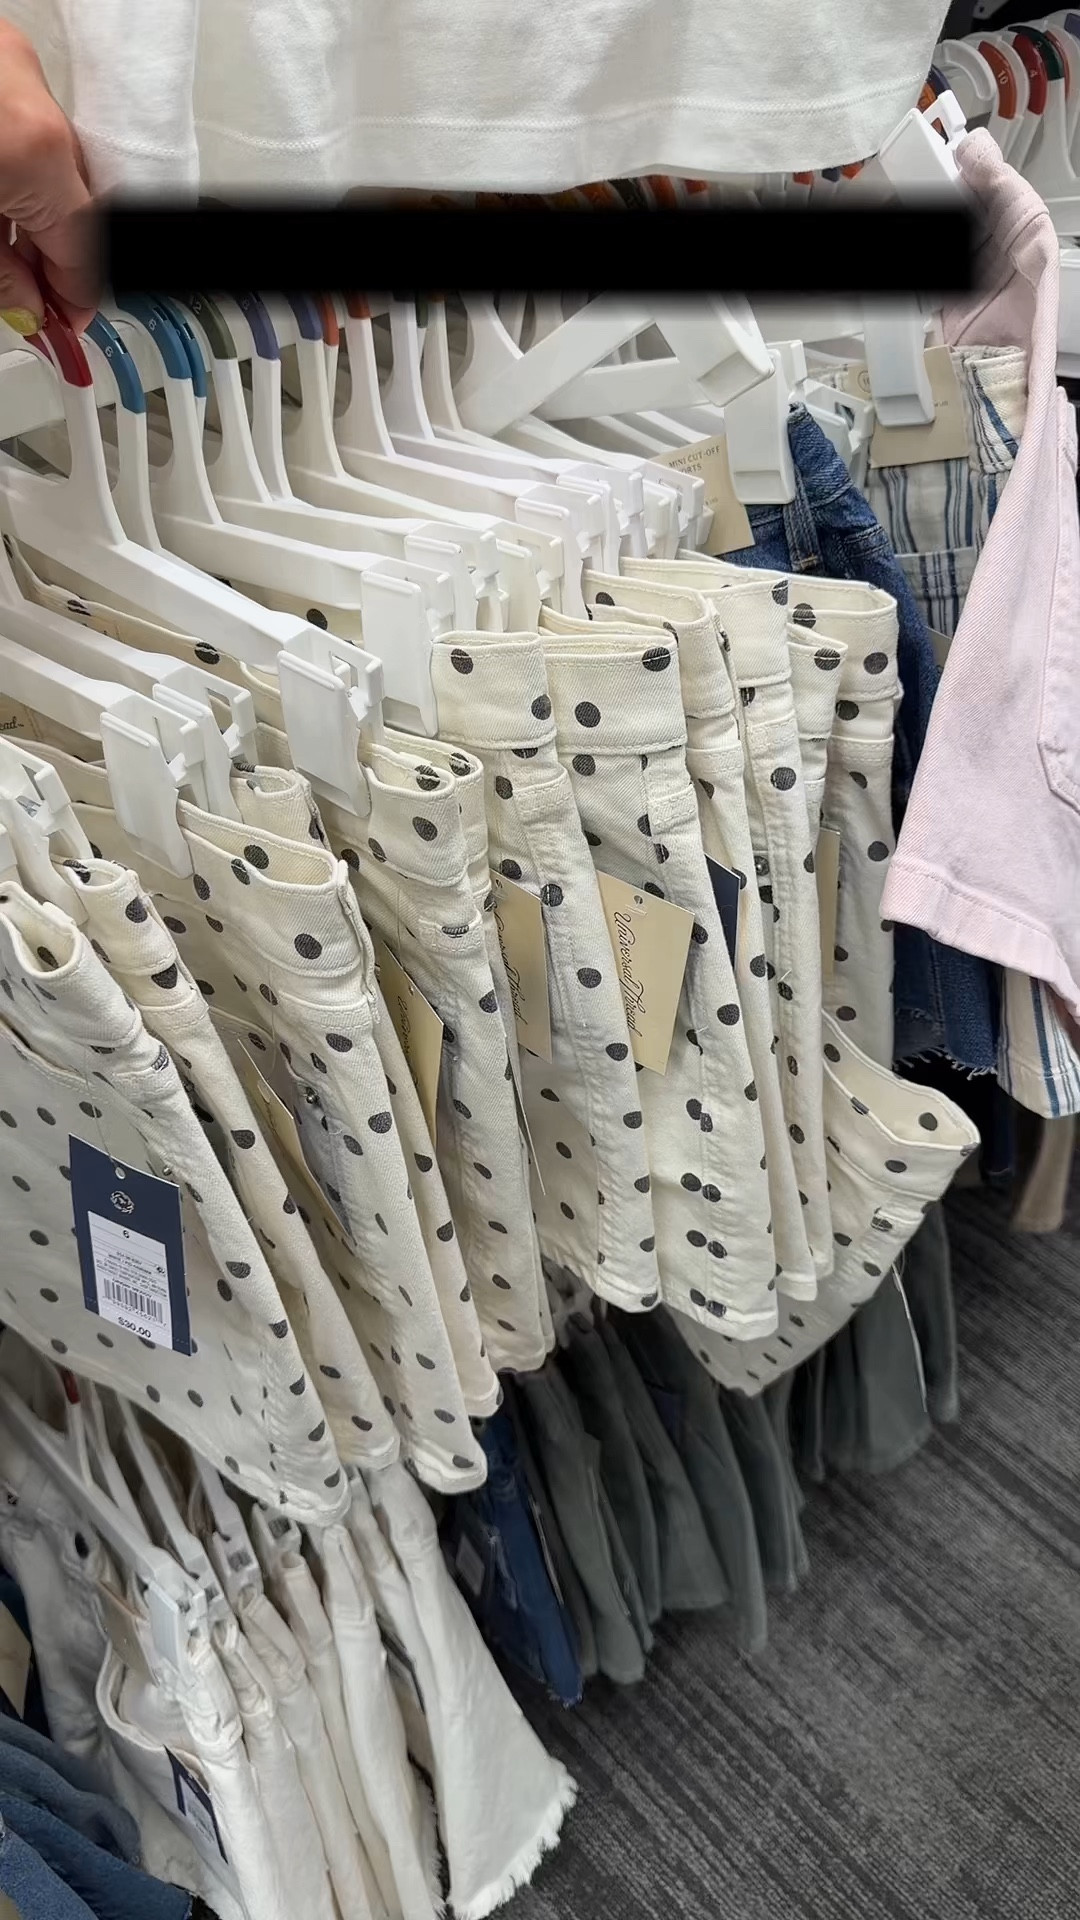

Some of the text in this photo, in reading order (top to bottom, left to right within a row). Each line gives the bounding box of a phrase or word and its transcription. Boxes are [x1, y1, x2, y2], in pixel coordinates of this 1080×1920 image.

[997, 69, 1009, 85] 10
[668, 445, 721, 469] MINI CUT-OFF
[680, 463, 703, 474] ORTS
[613, 911, 646, 1037] Universal Thread
[117, 1316, 152, 1339] $30.00
